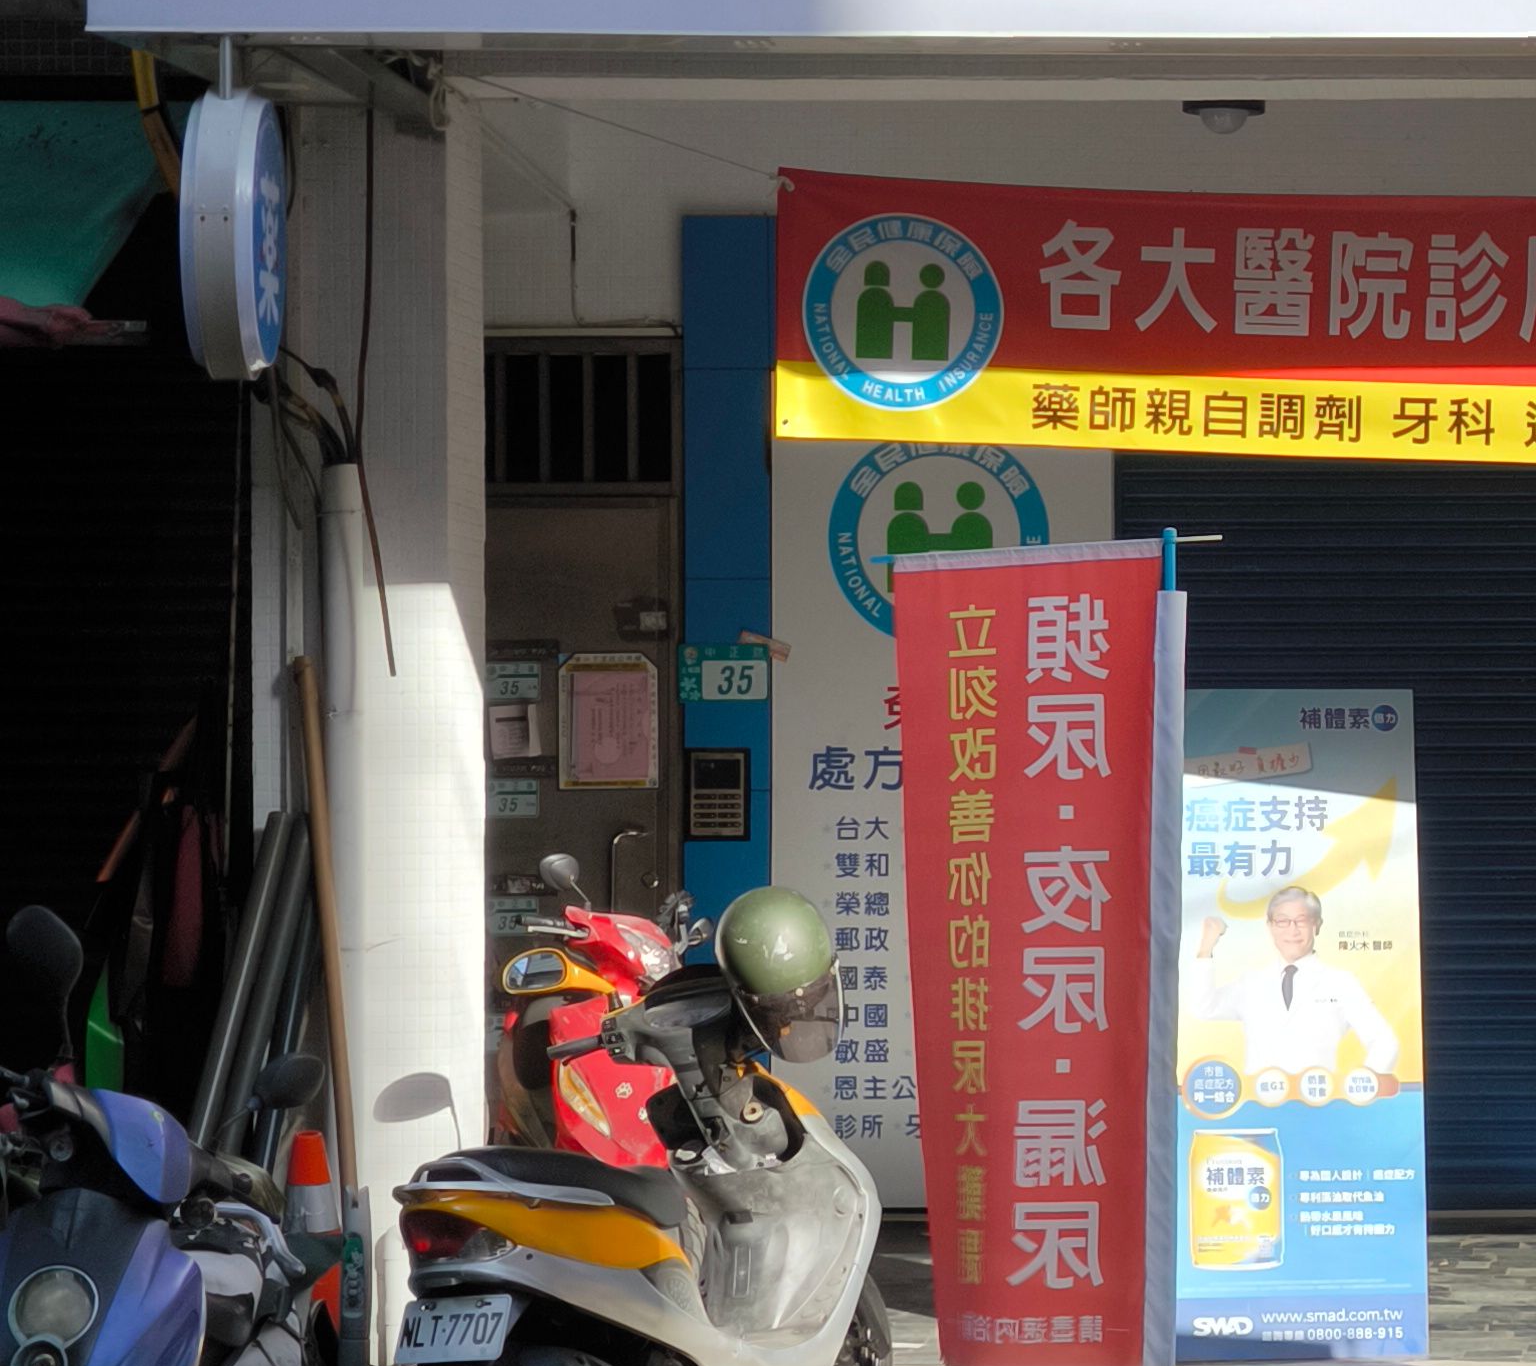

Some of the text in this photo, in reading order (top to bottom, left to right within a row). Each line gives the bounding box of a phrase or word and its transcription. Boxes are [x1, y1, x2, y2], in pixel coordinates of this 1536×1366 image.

[825, 219, 984, 281] 全民健康保險
[813, 302, 994, 403] NATIONAL HEALTH INSURANCE
[1030, 382, 1362, 443] 藥師親自調劑
[1391, 396, 1496, 447] 牙科
[837, 531, 883, 618] NATIONAL
[499, 680, 520, 696] 35
[717, 665, 754, 695] 35
[1299, 707, 1370, 730] 補體素
[498, 797, 519, 813] 35
[1185, 795, 1329, 833] 癌症支持
[834, 816, 890, 842] 台大
[834, 852, 890, 878] 雙和
[1186, 838, 1294, 878] 最有力
[834, 891, 890, 917] 榮總
[834, 926, 890, 953] 郵政
[834, 1038, 890, 1064] 敏盛
[834, 1115, 883, 1141] 診所
[1206, 1166, 1266, 1186] 補體素
[1192, 1316, 1254, 1338] SMAD
[1261, 1307, 1404, 1325] www.smad.com.tw
[1307, 1326, 1404, 1342] 0800-888-915
